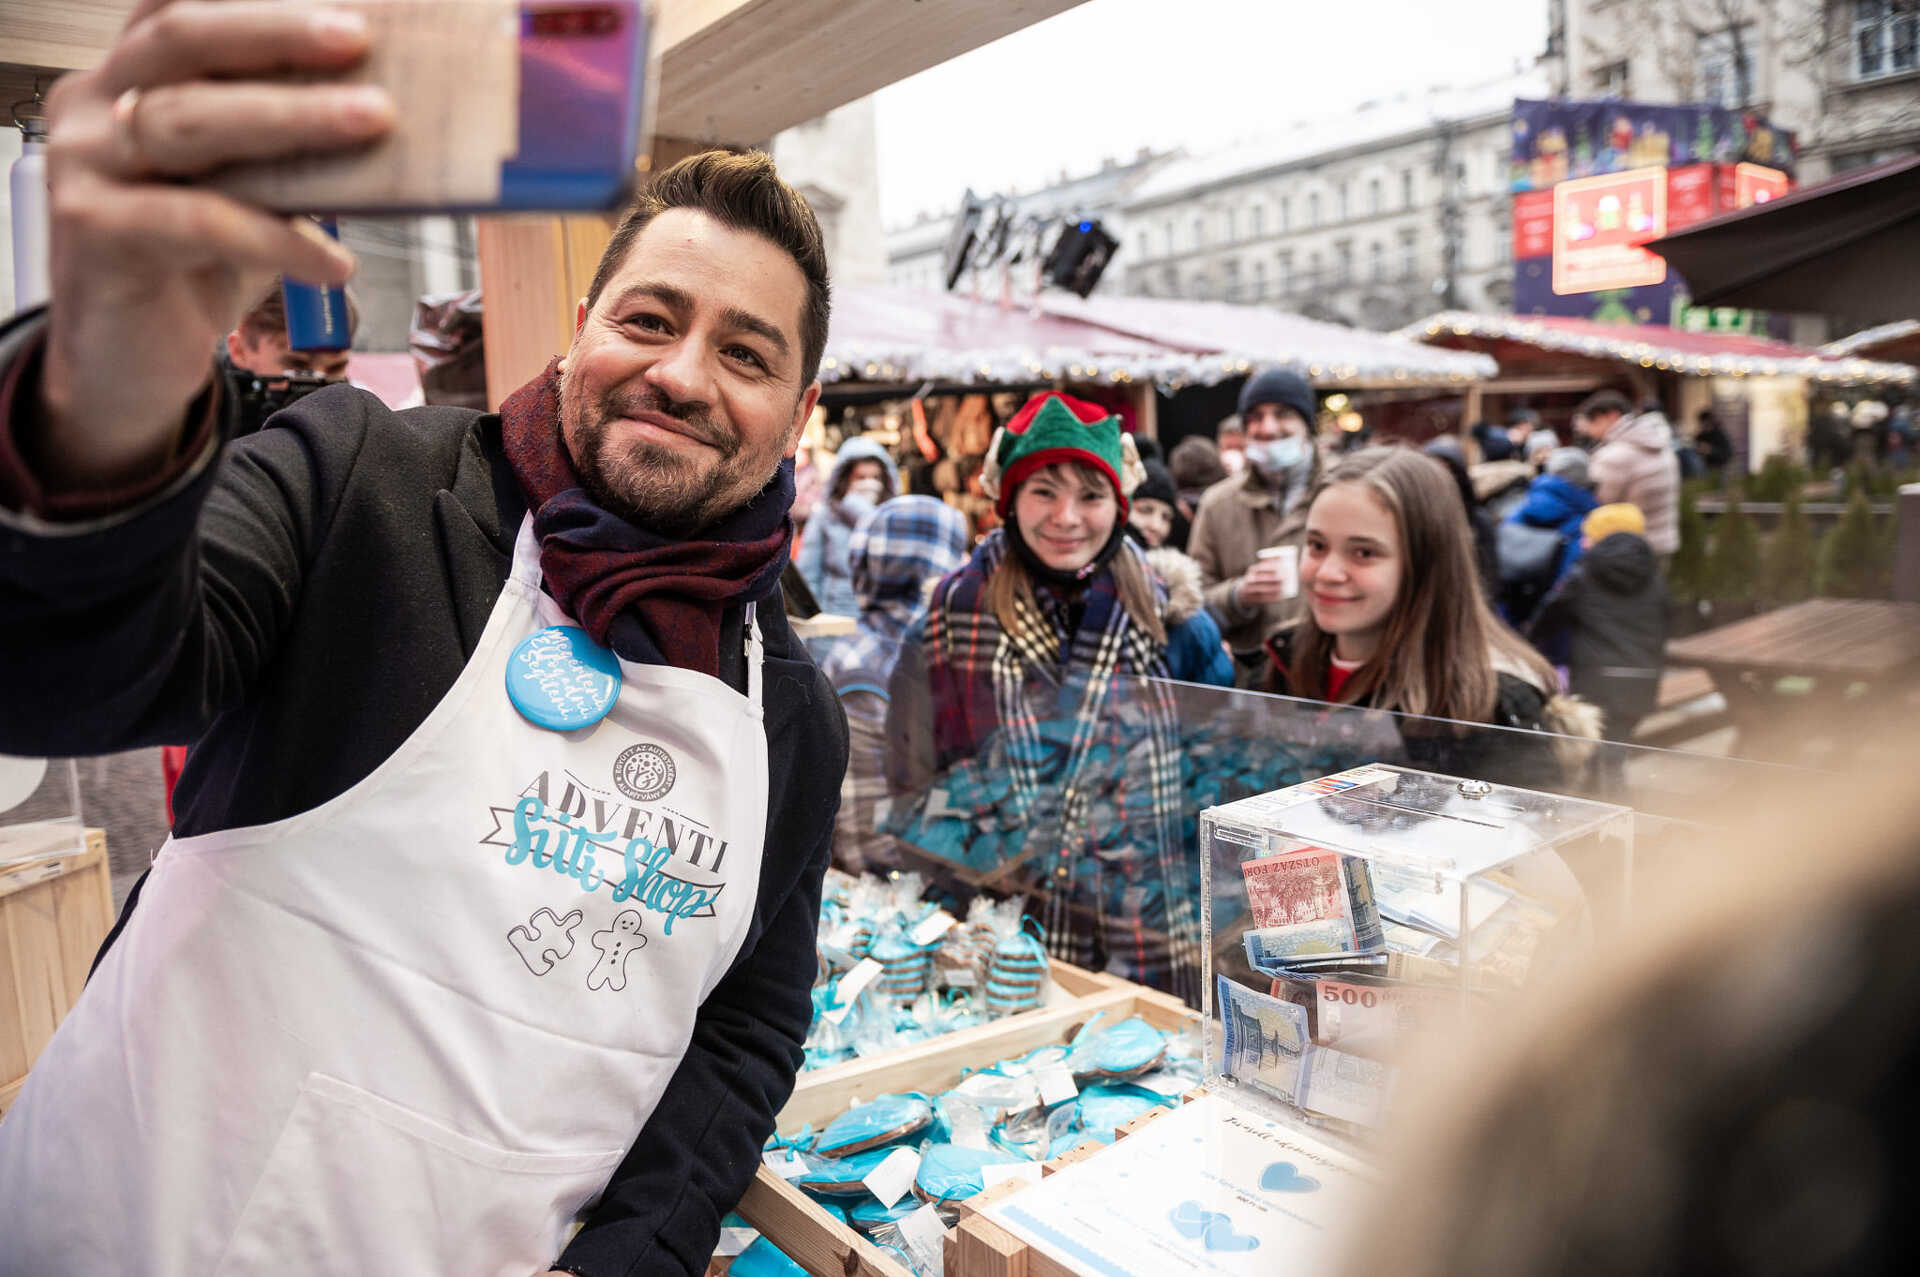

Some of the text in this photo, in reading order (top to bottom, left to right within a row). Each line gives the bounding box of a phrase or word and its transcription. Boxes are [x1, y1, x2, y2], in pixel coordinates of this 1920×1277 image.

[518, 770, 729, 874] ADVENTI
[612, 838, 719, 936] Shop
[1323, 985, 1377, 1009] 500
